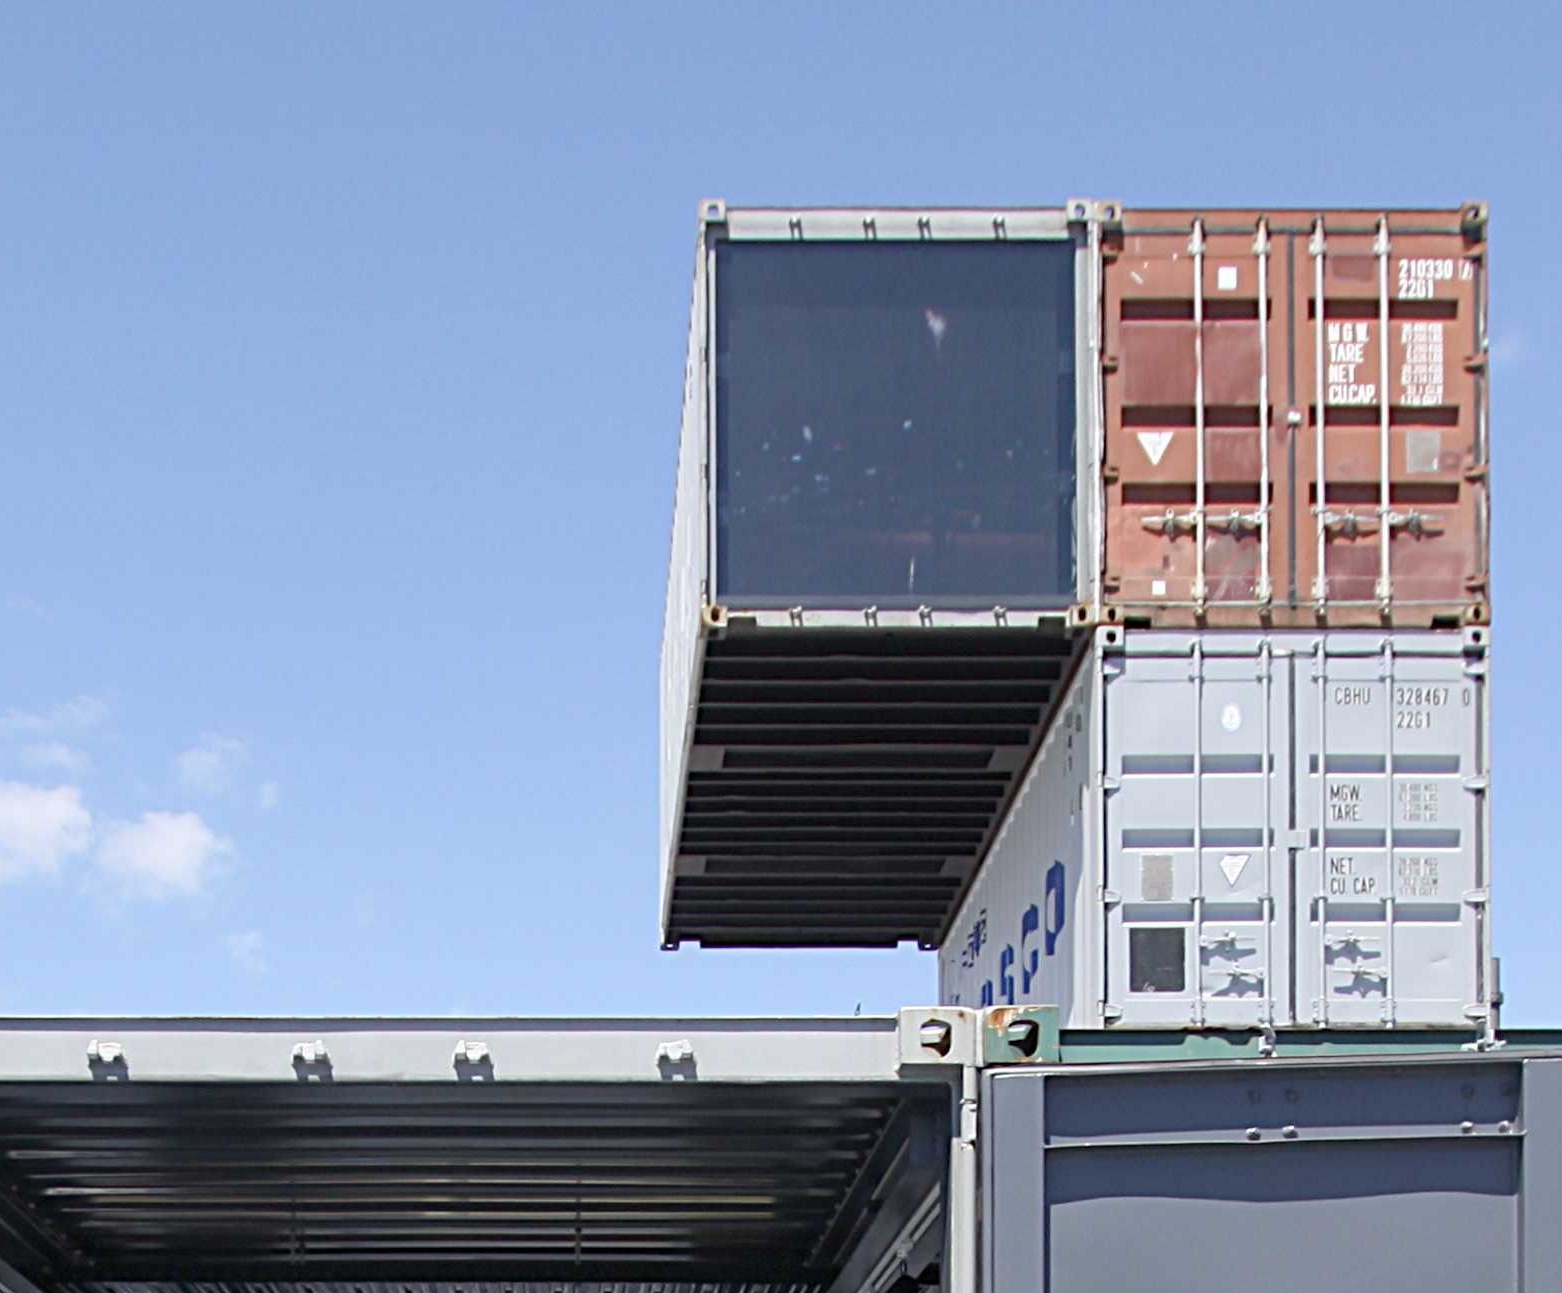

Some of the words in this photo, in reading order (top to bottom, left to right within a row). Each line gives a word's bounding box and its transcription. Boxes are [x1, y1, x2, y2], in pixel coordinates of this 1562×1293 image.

[1398, 259, 1453, 279] 210330
[1329, 343, 1364, 362] TARE
[1329, 364, 1356, 383] NET
[1334, 688, 1371, 705] CBHU
[1396, 688, 1449, 706] 328467
[1397, 711, 1431, 728] 22G1
